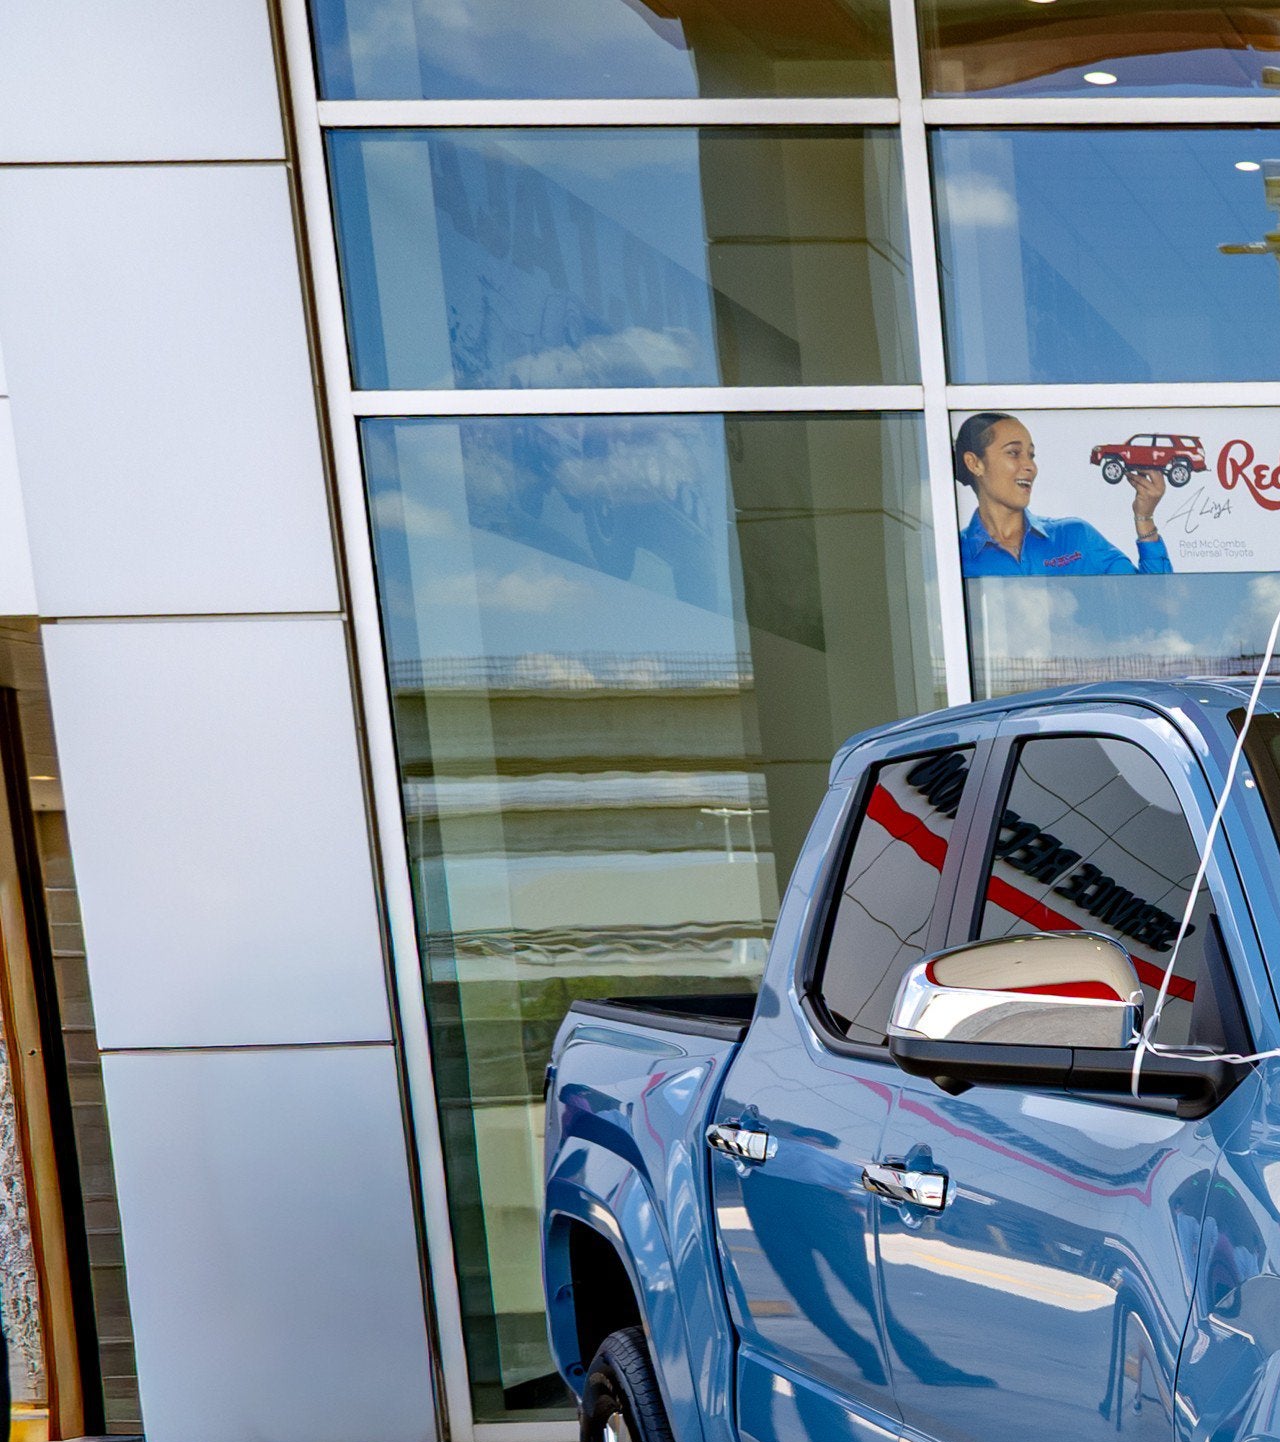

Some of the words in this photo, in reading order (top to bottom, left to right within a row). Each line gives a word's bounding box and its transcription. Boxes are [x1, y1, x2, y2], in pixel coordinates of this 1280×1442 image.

[1179, 540, 1198, 549] Red
[1199, 539, 1247, 549] McCombs
[1179, 549, 1222, 559] Universal
[1224, 549, 1255, 560] Toyota
